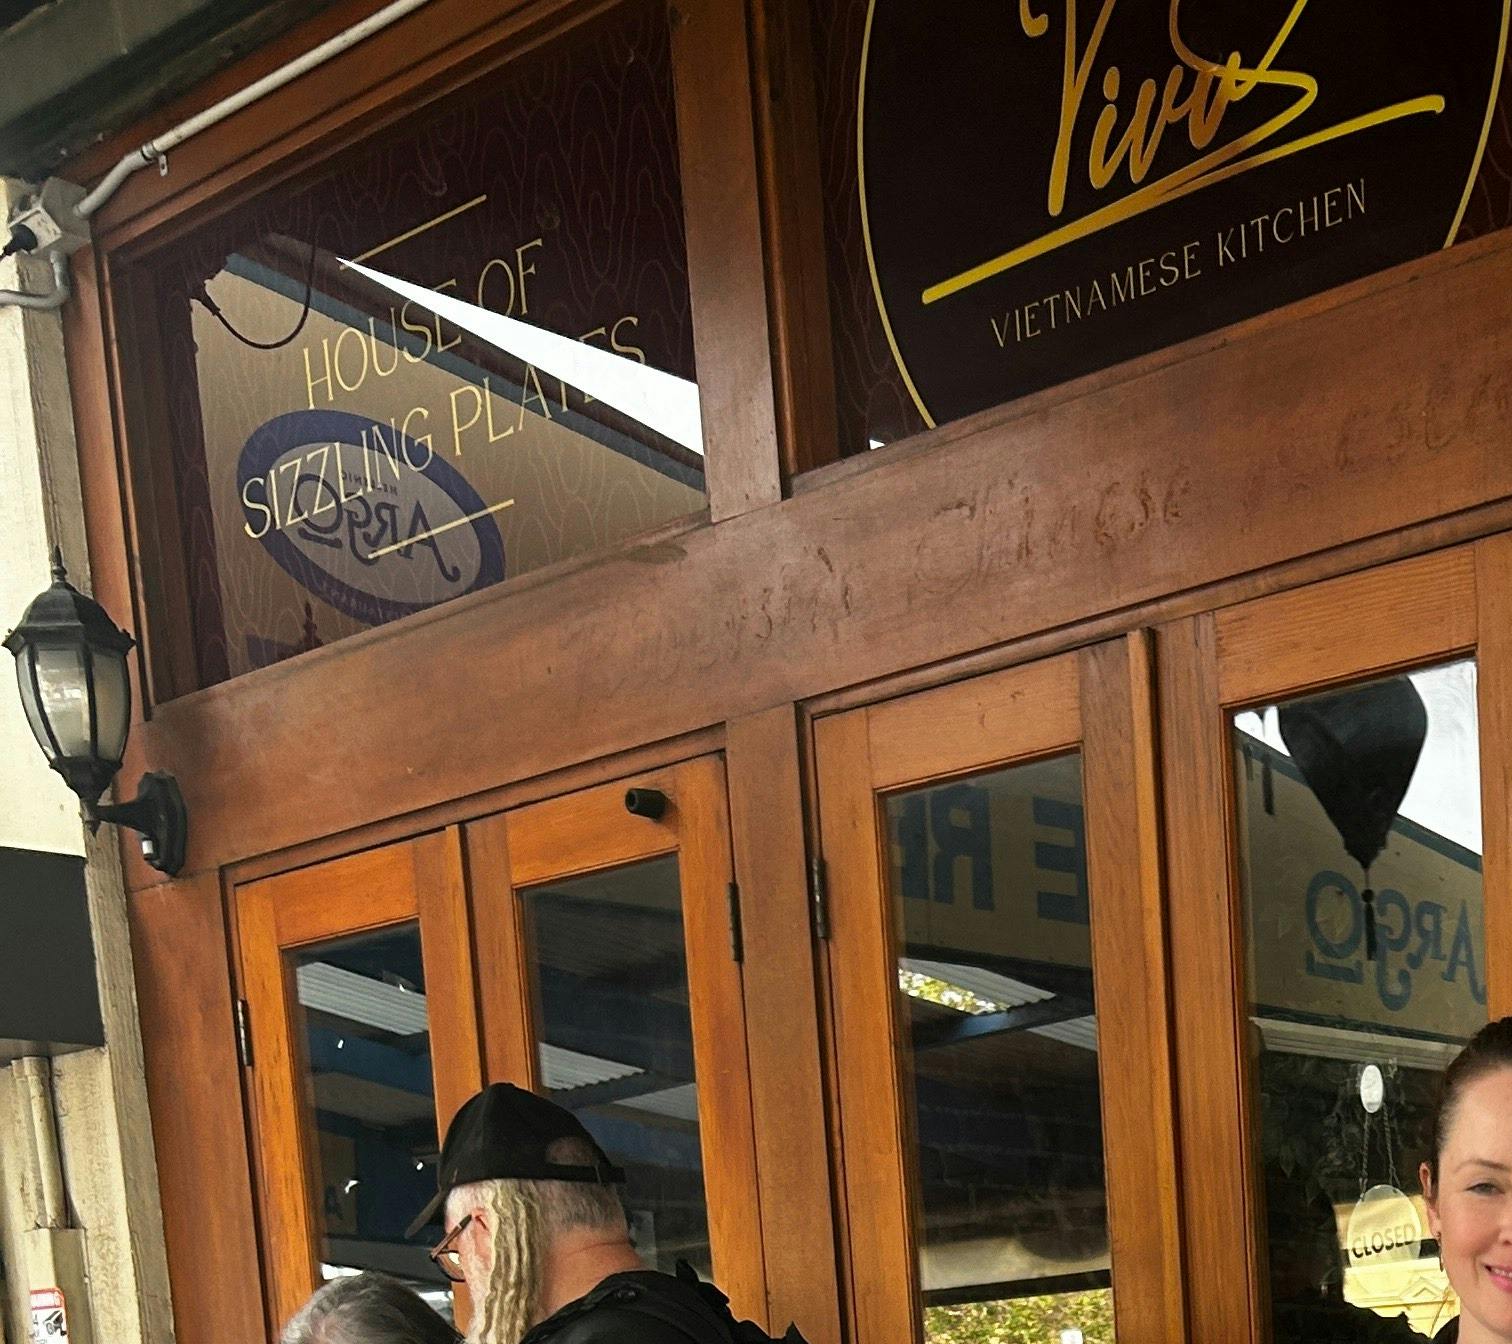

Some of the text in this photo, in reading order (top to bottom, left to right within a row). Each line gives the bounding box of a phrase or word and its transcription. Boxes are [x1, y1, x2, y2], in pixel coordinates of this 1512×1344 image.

[302, 237, 544, 411] HOUSE OF
[990, 177, 1366, 349] VIETNAMESE KITCHEN
[242, 406, 434, 540] SIZZLING
[1352, 1223, 1416, 1258] CLOSED
